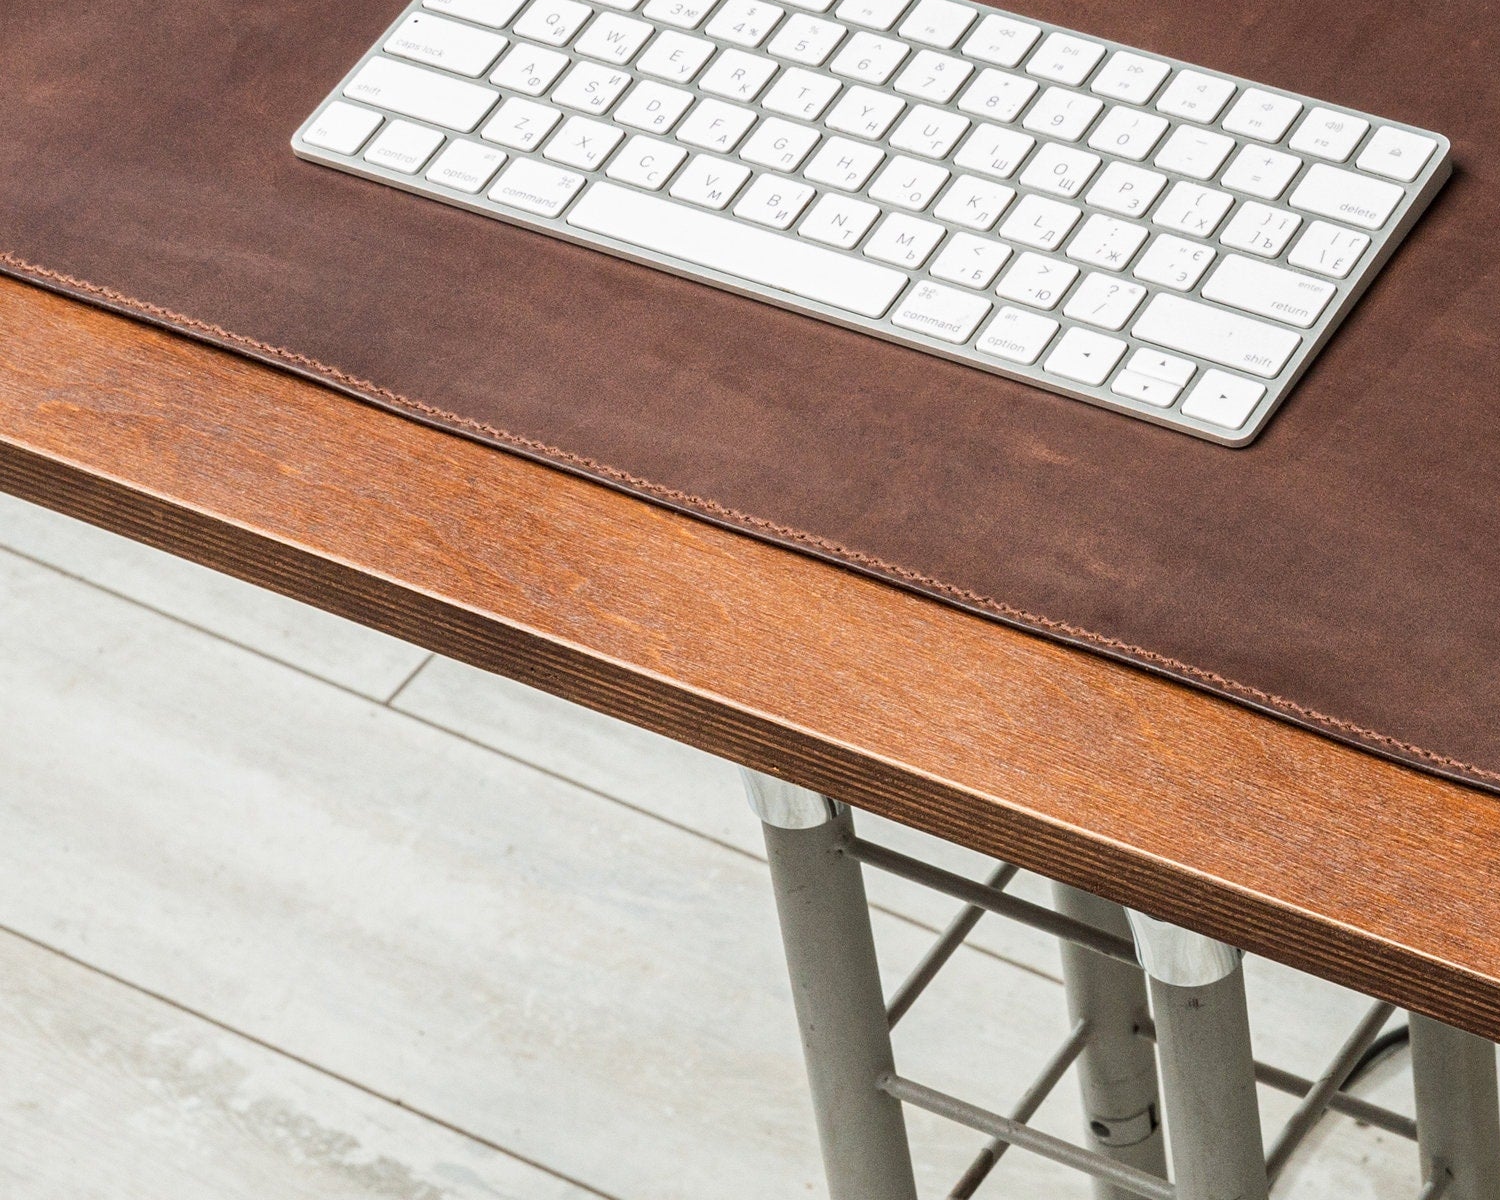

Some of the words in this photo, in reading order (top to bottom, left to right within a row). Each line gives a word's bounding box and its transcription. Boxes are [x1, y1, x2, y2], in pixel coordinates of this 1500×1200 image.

[670, 4, 683, 15] 3
[546, 14, 560, 26] Q
[733, 23, 744, 32] 4
[607, 31, 625, 43] W
[396, 39, 421, 50] caps
[422, 46, 444, 57] lock
[795, 40, 809, 51] 5
[669, 49, 683, 62] E
[521, 63, 534, 74] A
[858, 59, 871, 70] 6
[731, 68, 746, 80] R
[528, 78, 540, 86] Ф
[585, 81, 599, 93] S
[922, 77, 936, 87] 7
[356, 84, 381, 95] shift
[798, 87, 810, 98] T
[590, 96, 605, 105] Ы
[646, 100, 661, 111] D
[986, 96, 999, 107] 8
[861, 106, 874, 117] Y
[514, 117, 530, 130] Z
[709, 119, 724, 128] F
[1051, 114, 1064, 126] 9
[923, 125, 939, 137] U
[576, 136, 592, 148] X
[774, 138, 788, 150] G
[1314, 139, 1329, 147] F12
[377, 148, 417, 164] control
[640, 156, 654, 168] C
[837, 156, 853, 169] H
[1053, 163, 1068, 175] O
[441, 169, 478, 185] option
[706, 174, 719, 186] V
[903, 178, 917, 188] J
[1119, 182, 1134, 193] P
[502, 188, 557, 209] command
[766, 194, 781, 207] B
[967, 195, 982, 208] K
[1338, 204, 1376, 219] delete
[831, 214, 848, 227] N
[1034, 216, 1042, 228] L
[896, 233, 915, 246] M
[1040, 230, 1055, 242] Д
[1106, 250, 1121, 262] Ж
[971, 270, 983, 280] Б
[1107, 285, 1119, 297] ?
[1298, 280, 1324, 292] enter
[1035, 289, 1051, 300] Ю
[1270, 302, 1308, 318] return
[903, 311, 961, 334] command
[987, 337, 1025, 353] option
[1244, 354, 1272, 367] shift
